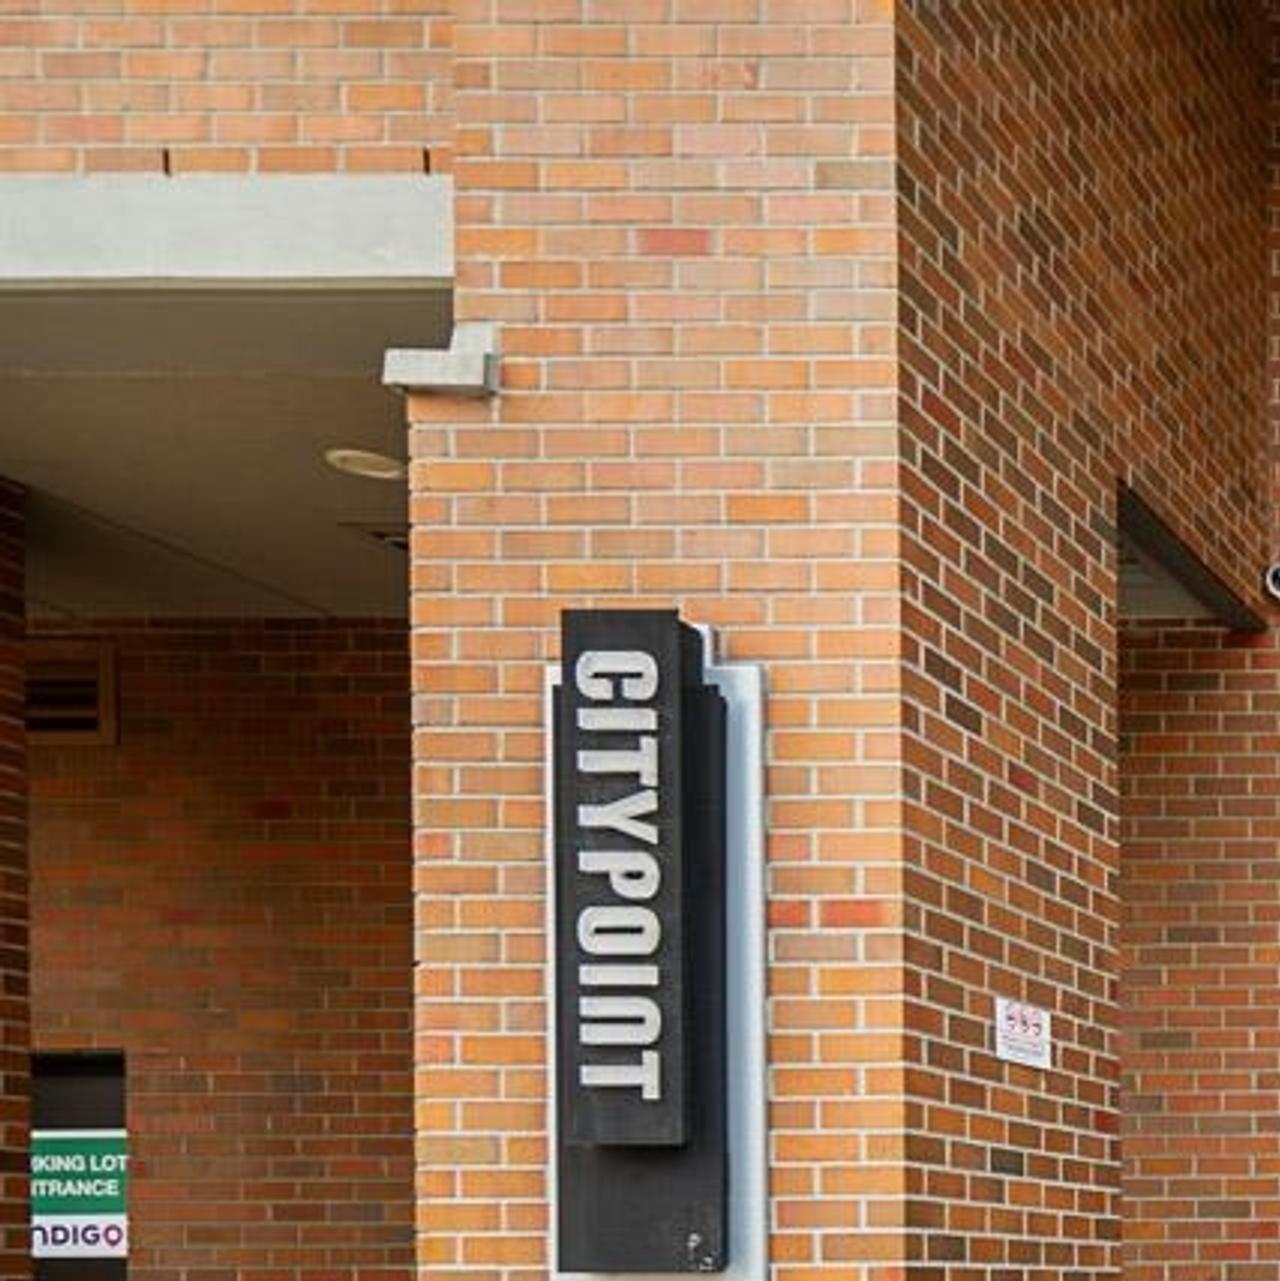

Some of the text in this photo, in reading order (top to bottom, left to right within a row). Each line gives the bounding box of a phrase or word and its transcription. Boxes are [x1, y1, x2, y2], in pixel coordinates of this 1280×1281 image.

[575, 649, 661, 1100] CITYPOINT
[90, 1154, 128, 1171] LOT
[31, 1179, 119, 1196] TRANCE
[33, 1224, 123, 1247] NDIGO
